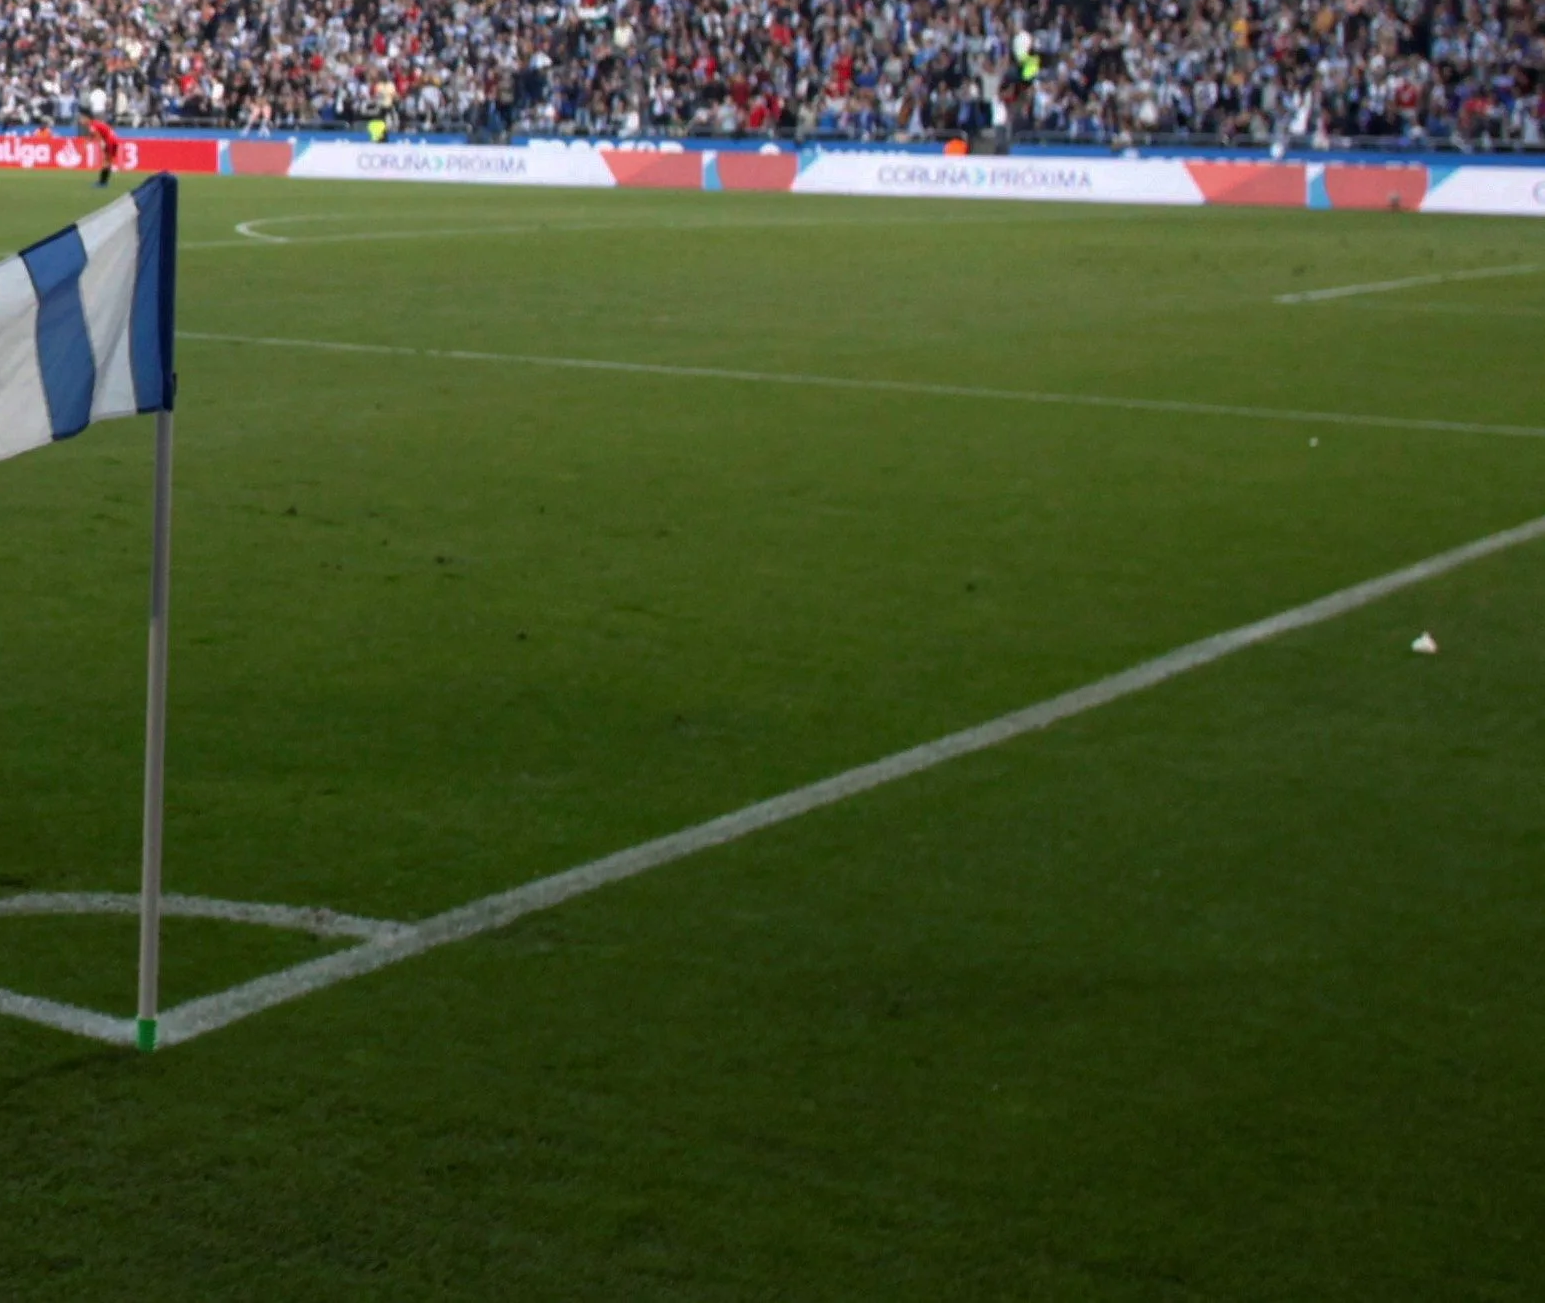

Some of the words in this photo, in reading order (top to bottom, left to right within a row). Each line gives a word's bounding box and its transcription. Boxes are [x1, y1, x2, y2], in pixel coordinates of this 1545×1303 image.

[357, 151, 432, 172] CORUÑA
[878, 162, 970, 185] CORUÑA
[988, 163, 1092, 188] PRÓXIMA
